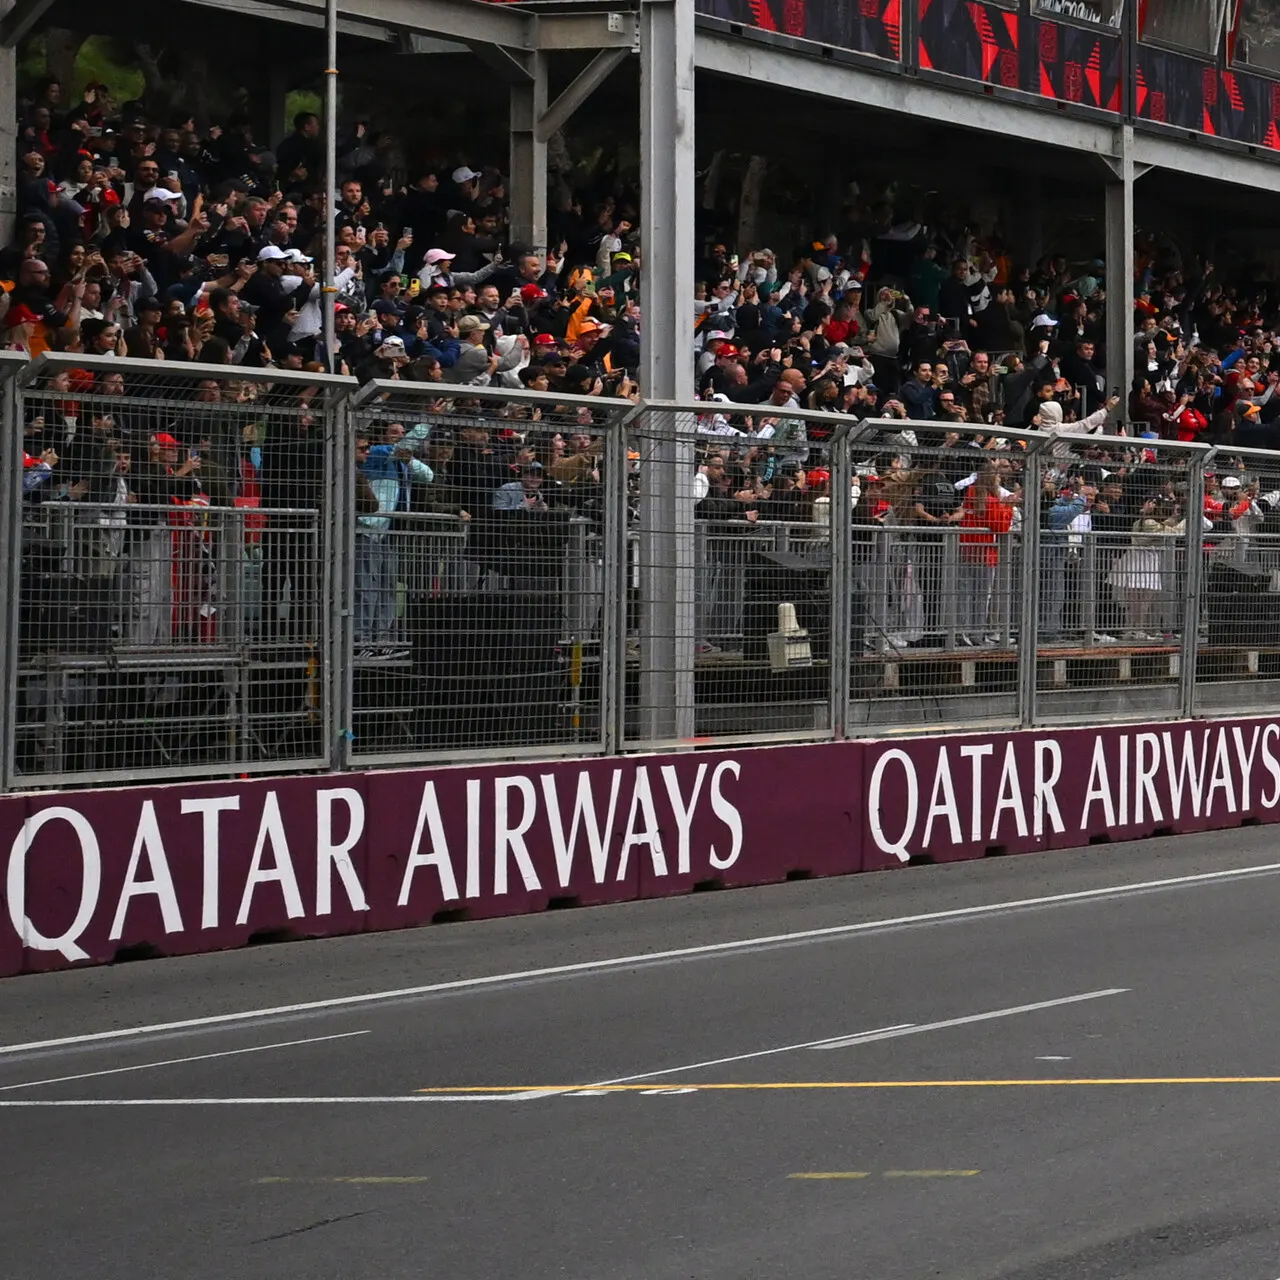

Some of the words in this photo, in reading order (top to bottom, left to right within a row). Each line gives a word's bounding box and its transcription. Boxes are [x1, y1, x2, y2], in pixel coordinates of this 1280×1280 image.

[6, 786, 370, 962] QATAR
[396, 760, 743, 906] AIRWAYS
[868, 739, 1066, 861] QATAR
